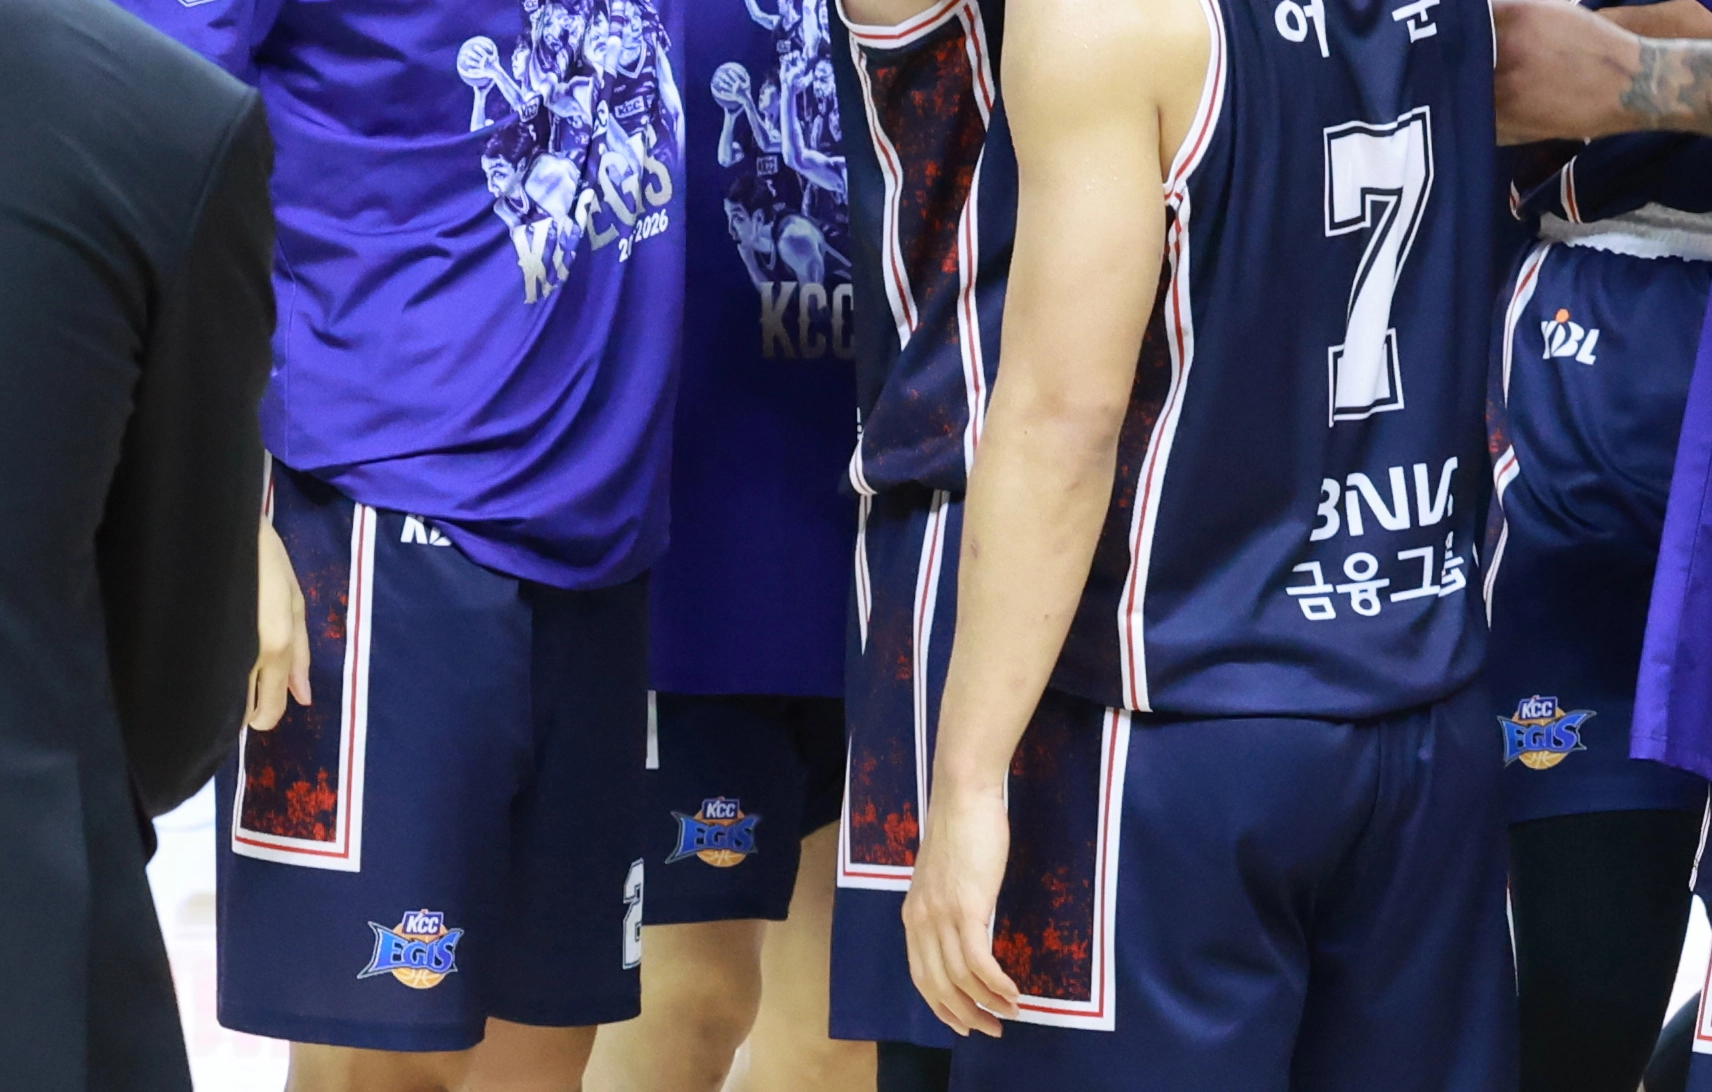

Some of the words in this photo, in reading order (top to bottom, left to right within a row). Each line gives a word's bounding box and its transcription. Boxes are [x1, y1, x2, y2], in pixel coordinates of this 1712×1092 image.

[1323, 105, 1434, 428] 7
[1520, 700, 1554, 720] KCC
[1497, 710, 1598, 766] EGIS
[705, 800, 737, 820] KCC
[670, 812, 760, 862] EGIS
[358, 921, 464, 978] EGIS
[405, 914, 439, 936] KCC
